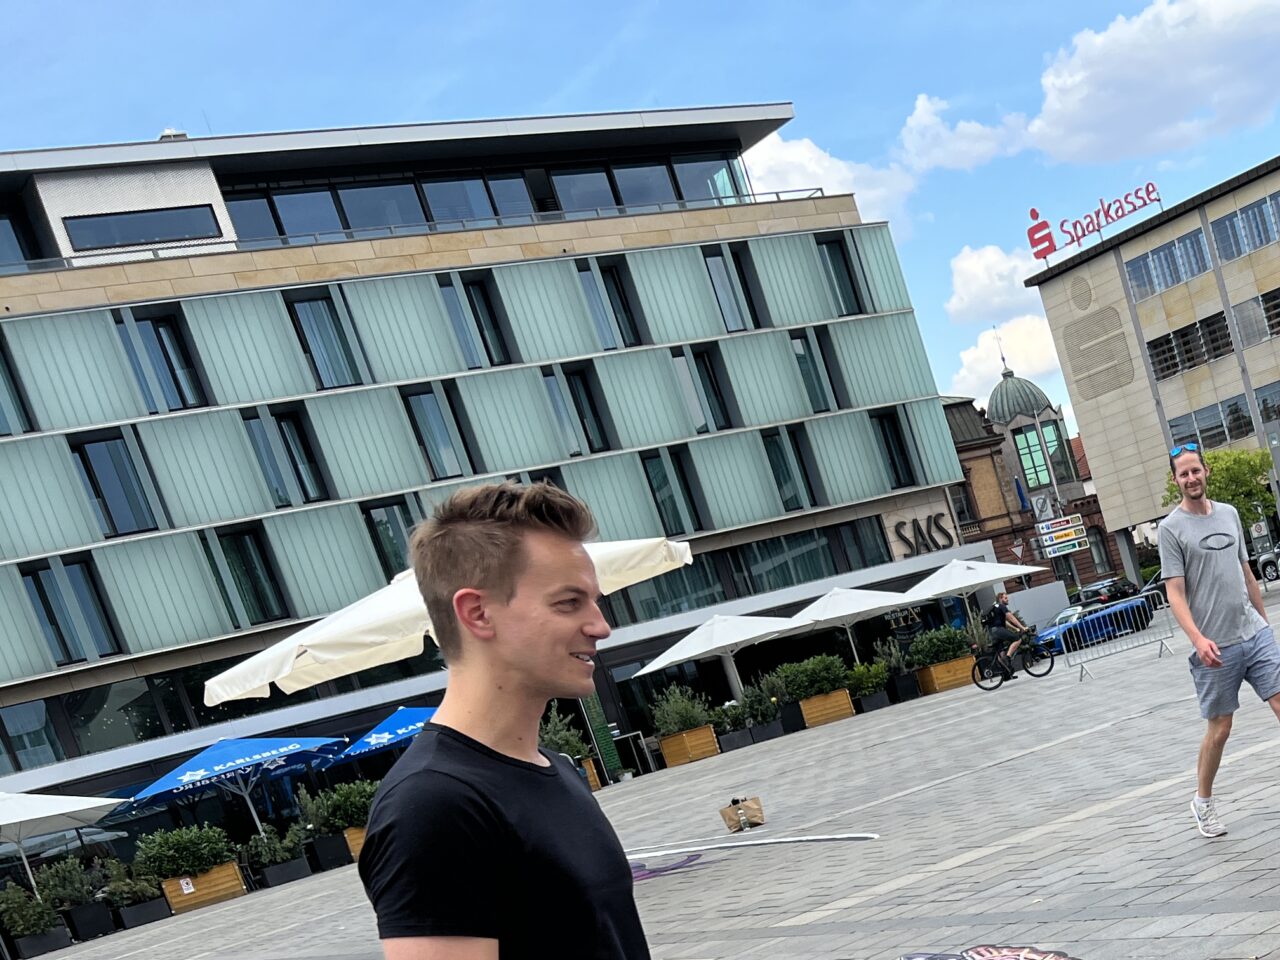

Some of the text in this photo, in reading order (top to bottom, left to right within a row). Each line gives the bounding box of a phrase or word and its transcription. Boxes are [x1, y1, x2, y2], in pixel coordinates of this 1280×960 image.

[1059, 182, 1159, 247] Sparkasse
[895, 512, 954, 558] SAKS
[213, 743, 302, 772] KARLSBERG
